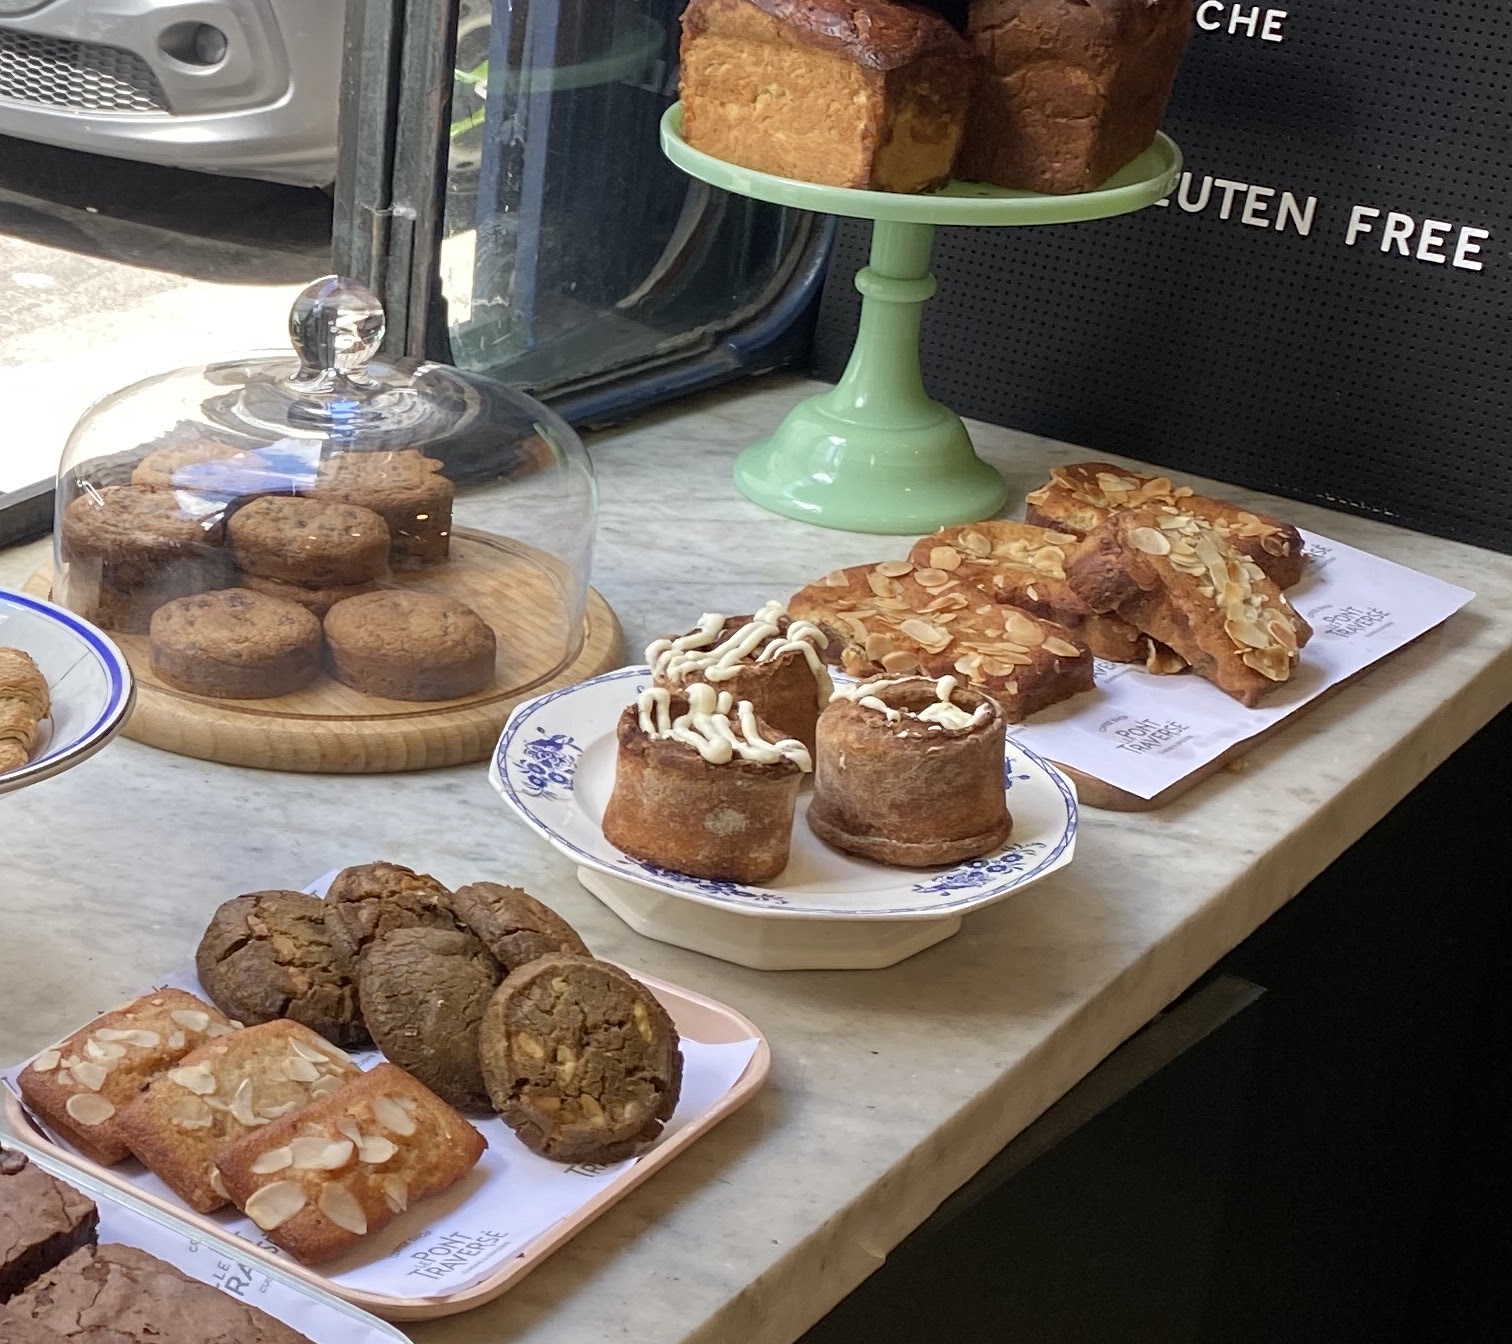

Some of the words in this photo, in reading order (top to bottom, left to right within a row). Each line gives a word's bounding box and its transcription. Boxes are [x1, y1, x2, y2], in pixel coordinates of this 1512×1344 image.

[1154, 171, 1318, 237] UTEN
[1345, 205, 1490, 272] FREE
[1115, 718, 1162, 742] PONT
[409, 1231, 473, 1264] PONT
